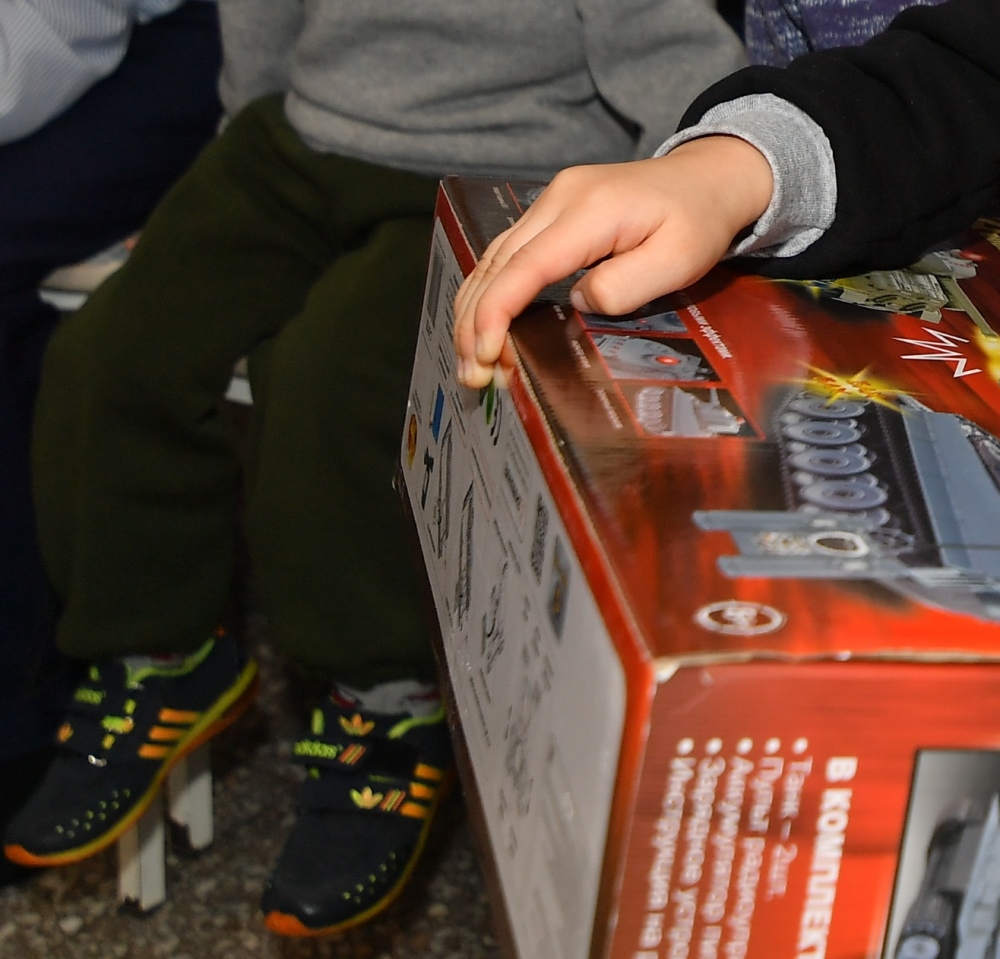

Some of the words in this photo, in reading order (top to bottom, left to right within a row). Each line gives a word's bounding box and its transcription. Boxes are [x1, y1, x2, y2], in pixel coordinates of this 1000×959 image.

[749, 757, 784, 832] Пульт
[780, 756, 813, 818] Танк
[826, 756, 857, 782] В
[648, 757, 696, 910] Инструкция
[680, 757, 726, 885] Зарядное
[725, 837, 765, 959] радиоупр
